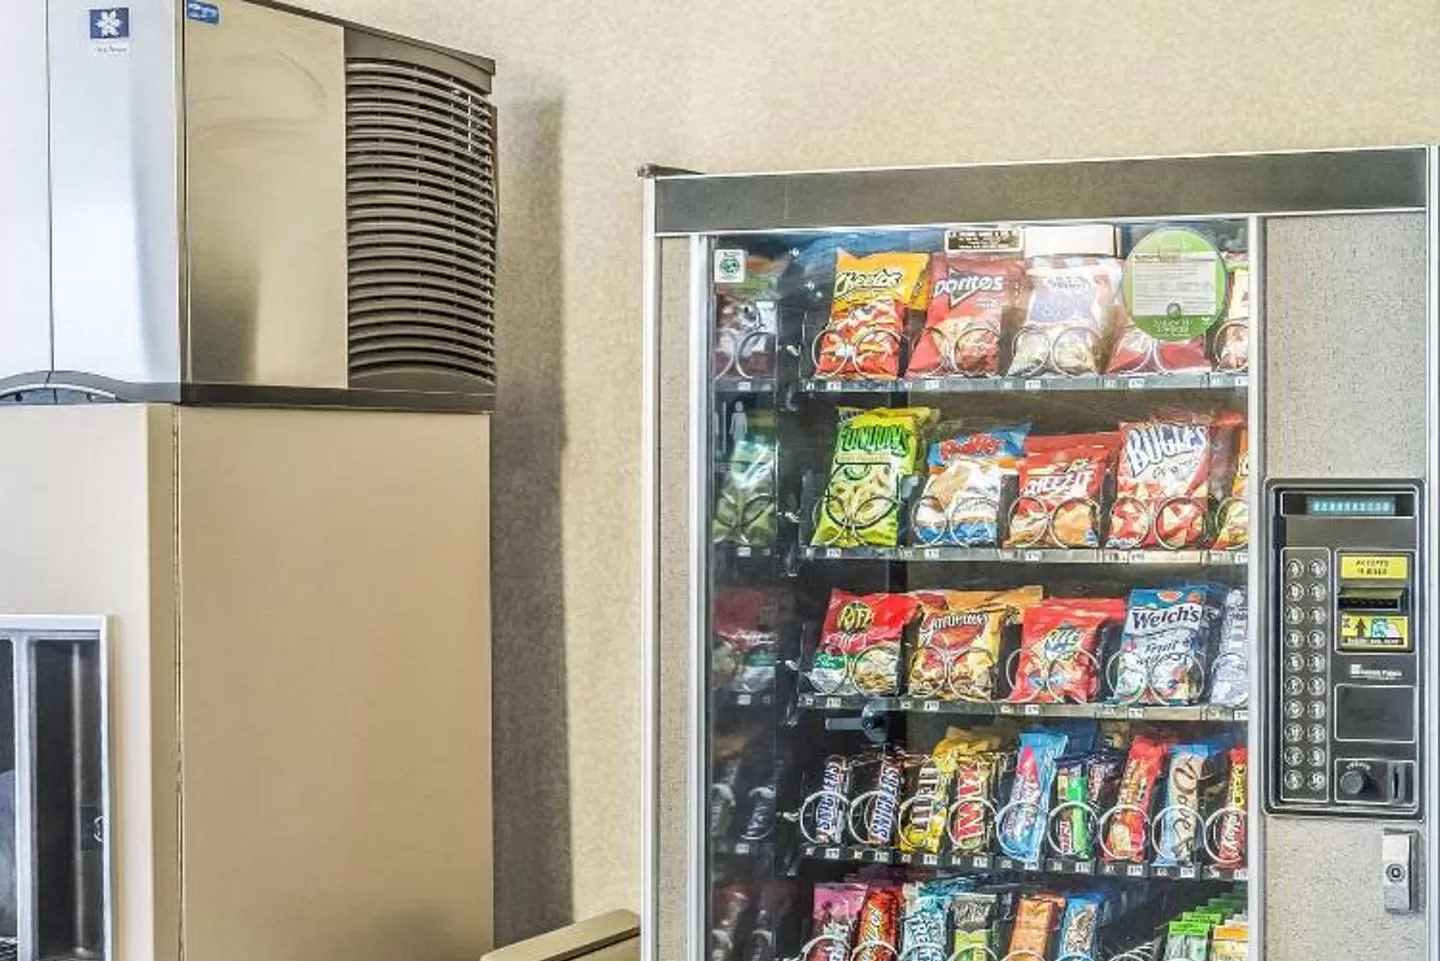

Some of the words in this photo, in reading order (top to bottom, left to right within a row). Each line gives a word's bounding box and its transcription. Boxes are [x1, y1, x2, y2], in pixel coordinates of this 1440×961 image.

[834, 268, 904, 298] Cheetos
[934, 275, 1004, 297] Doritos
[1132, 605, 1199, 629] Welch's
[954, 761, 985, 841] TWIX
